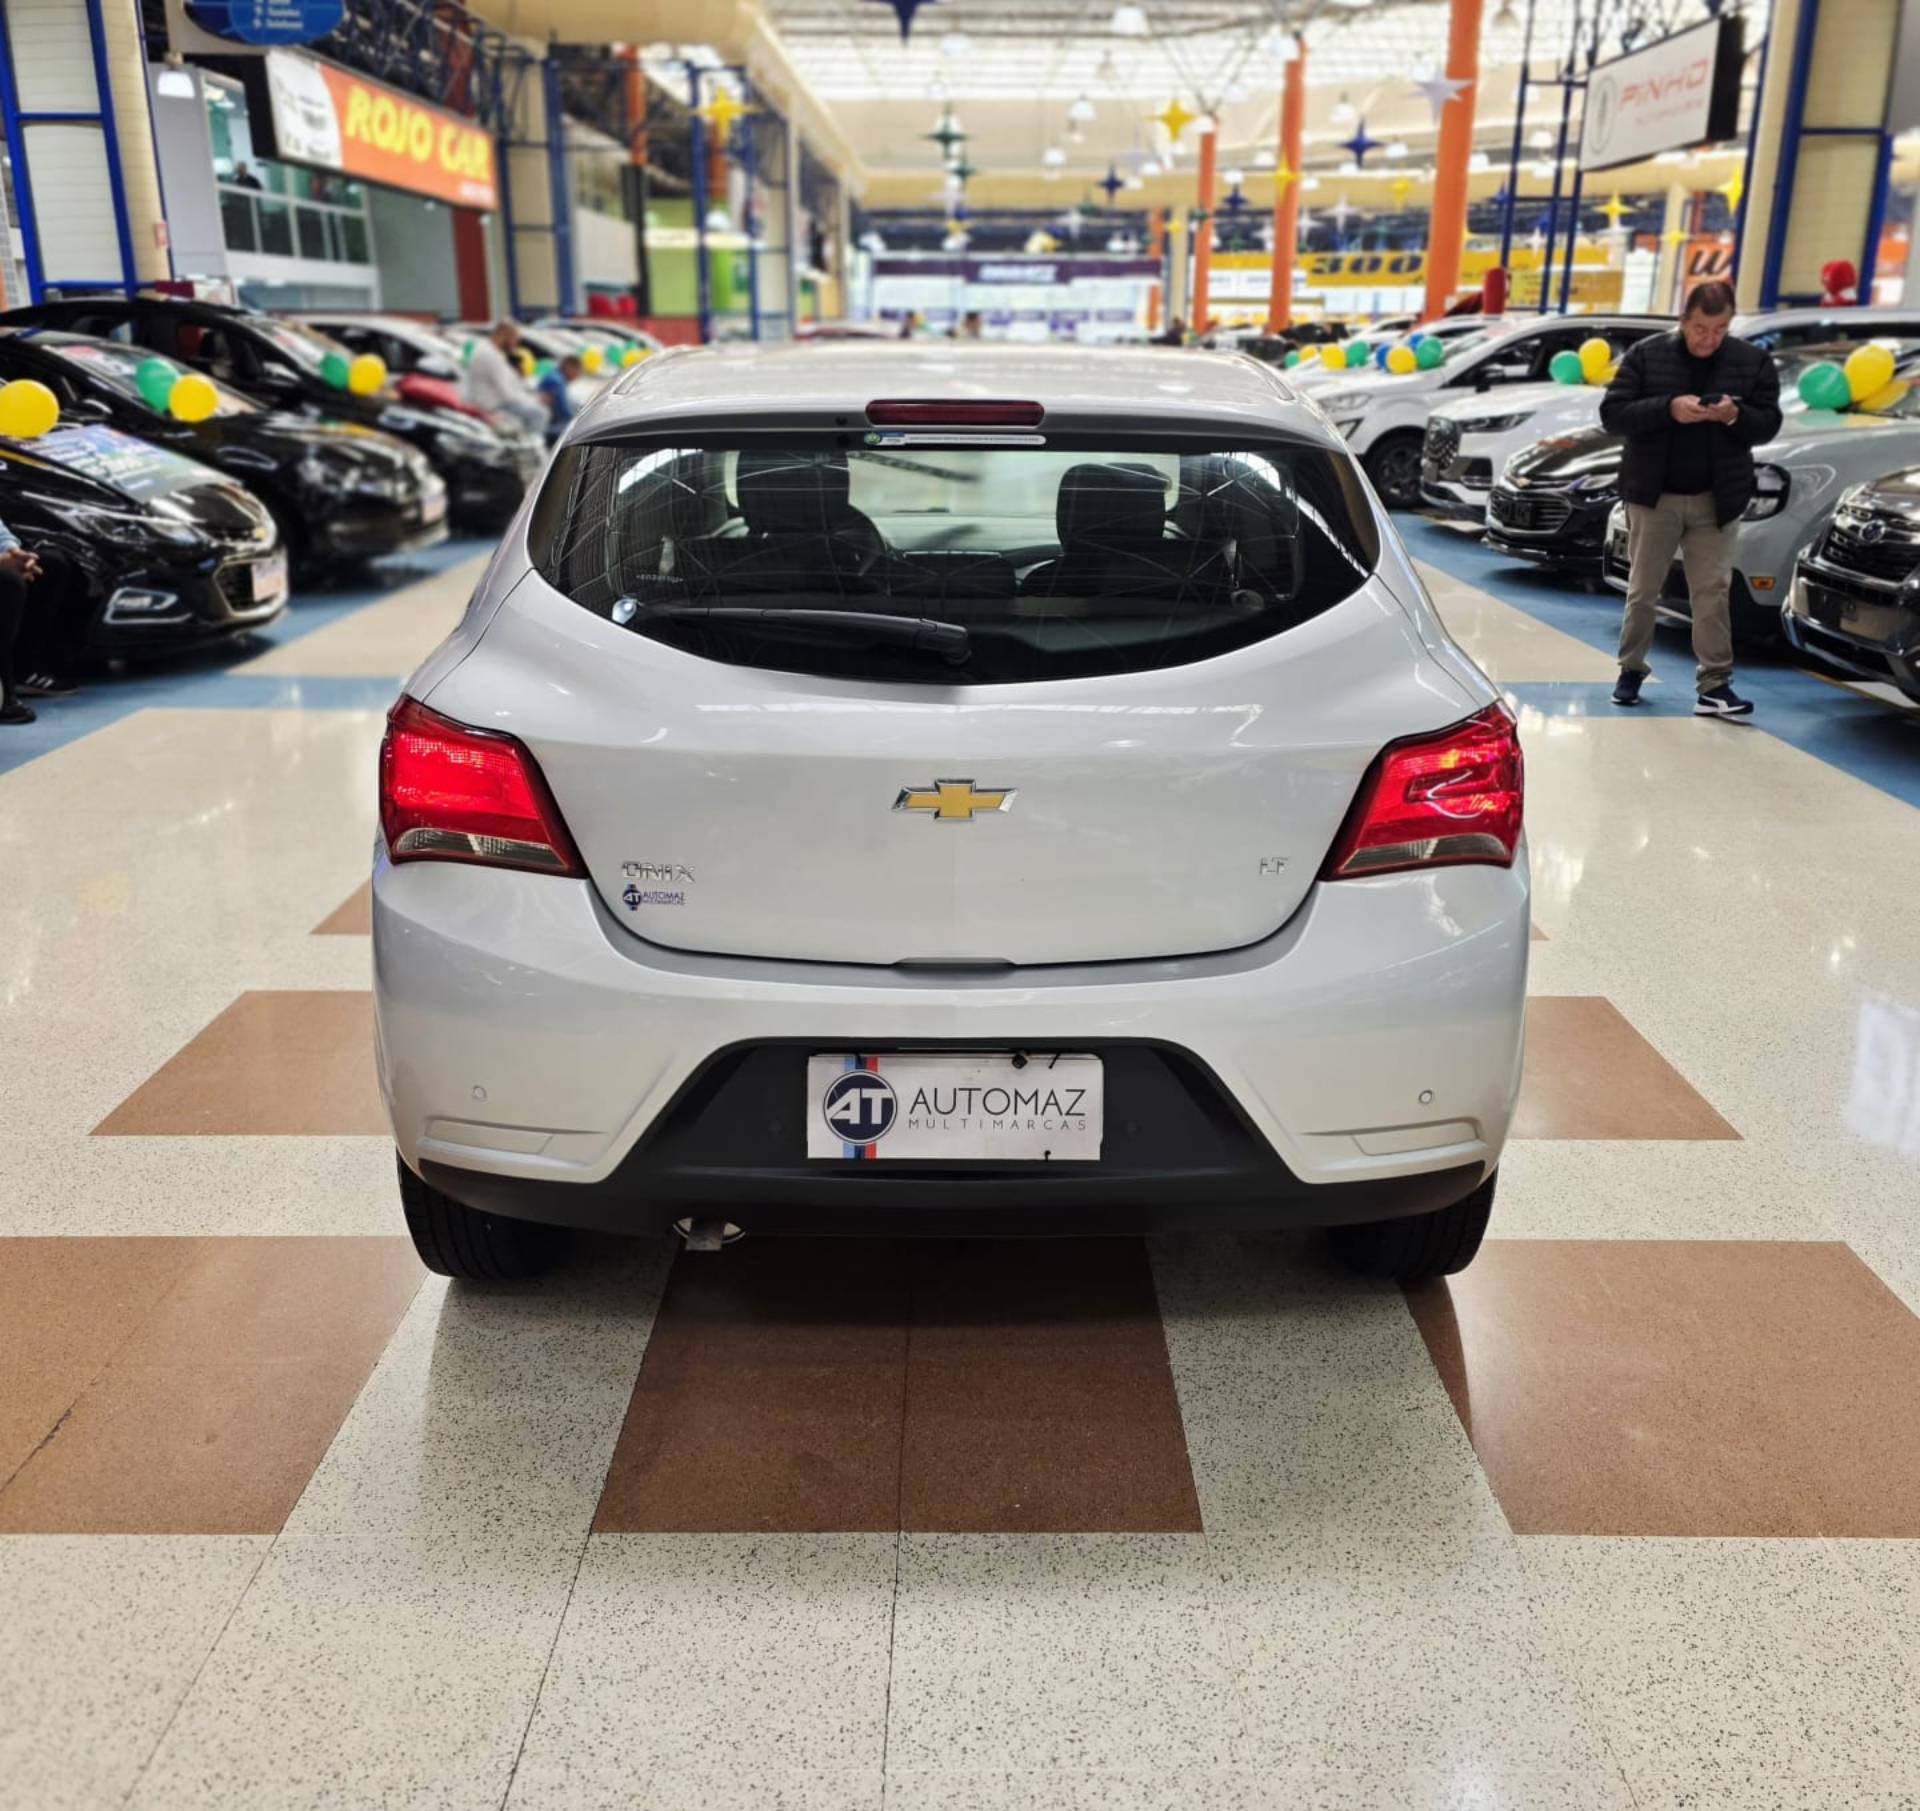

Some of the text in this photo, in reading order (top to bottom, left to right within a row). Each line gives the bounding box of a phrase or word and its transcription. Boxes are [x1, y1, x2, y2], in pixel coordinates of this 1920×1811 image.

[346, 85, 433, 163] ROJO
[439, 124, 490, 182] CAR
[1311, 256, 1423, 274] 300
[621, 861, 696, 882] ONIX
[827, 1087, 894, 1125] AT
[909, 1087, 1086, 1116] AUTOMAZ
[908, 1118, 1086, 1131] MULTIMARCAS
